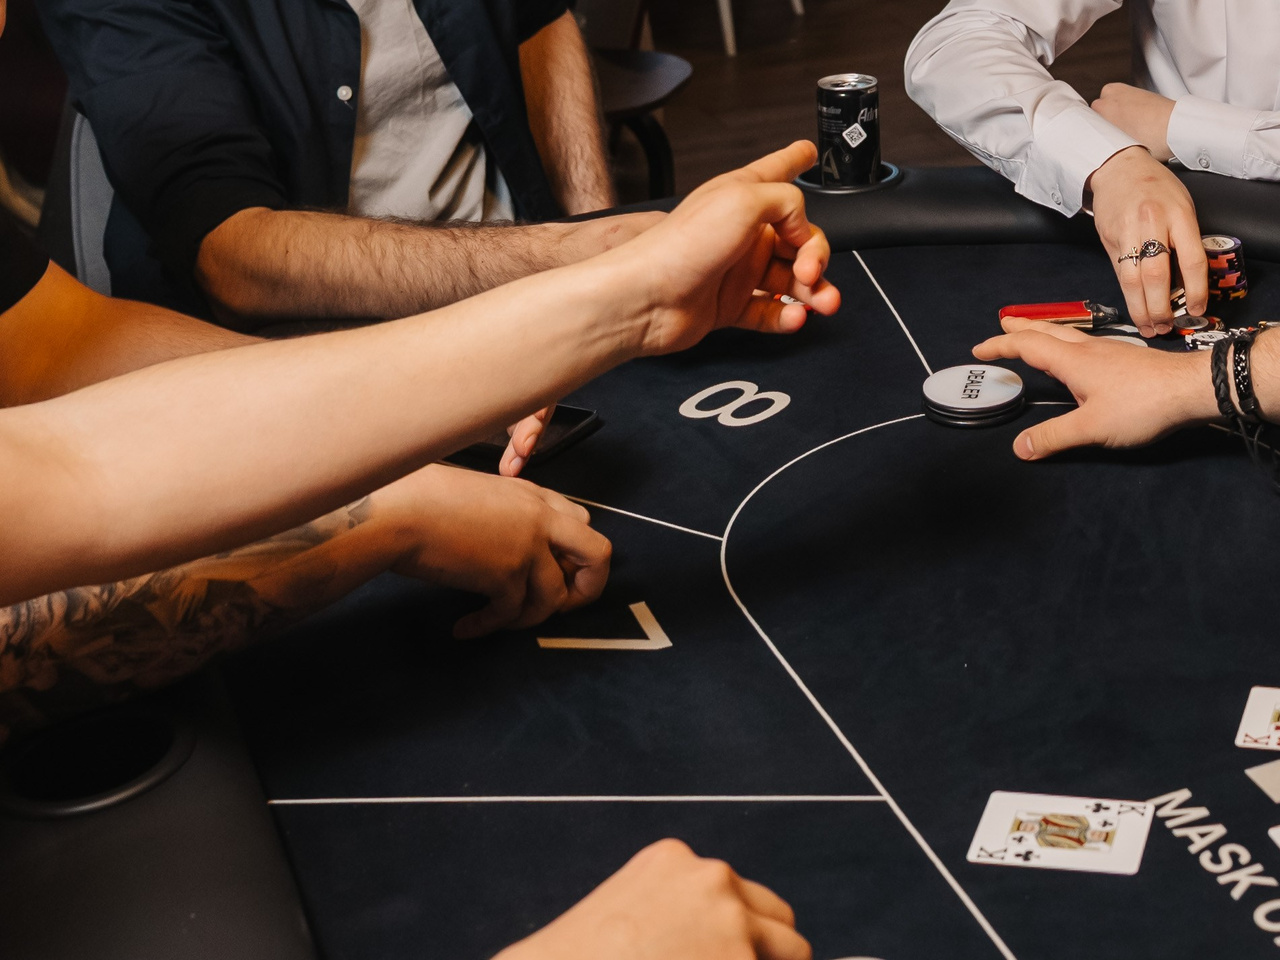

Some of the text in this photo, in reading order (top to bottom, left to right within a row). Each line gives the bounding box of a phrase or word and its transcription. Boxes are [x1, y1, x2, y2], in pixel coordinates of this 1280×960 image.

[961, 369, 986, 400] DEALER
[678, 380, 791, 427] 8
[536, 601, 673, 650] 7
[1243, 733, 1271, 746] K
[1117, 802, 1147, 816] K
[976, 846, 1007, 860] K
[1148, 788, 1279, 901] MASK
